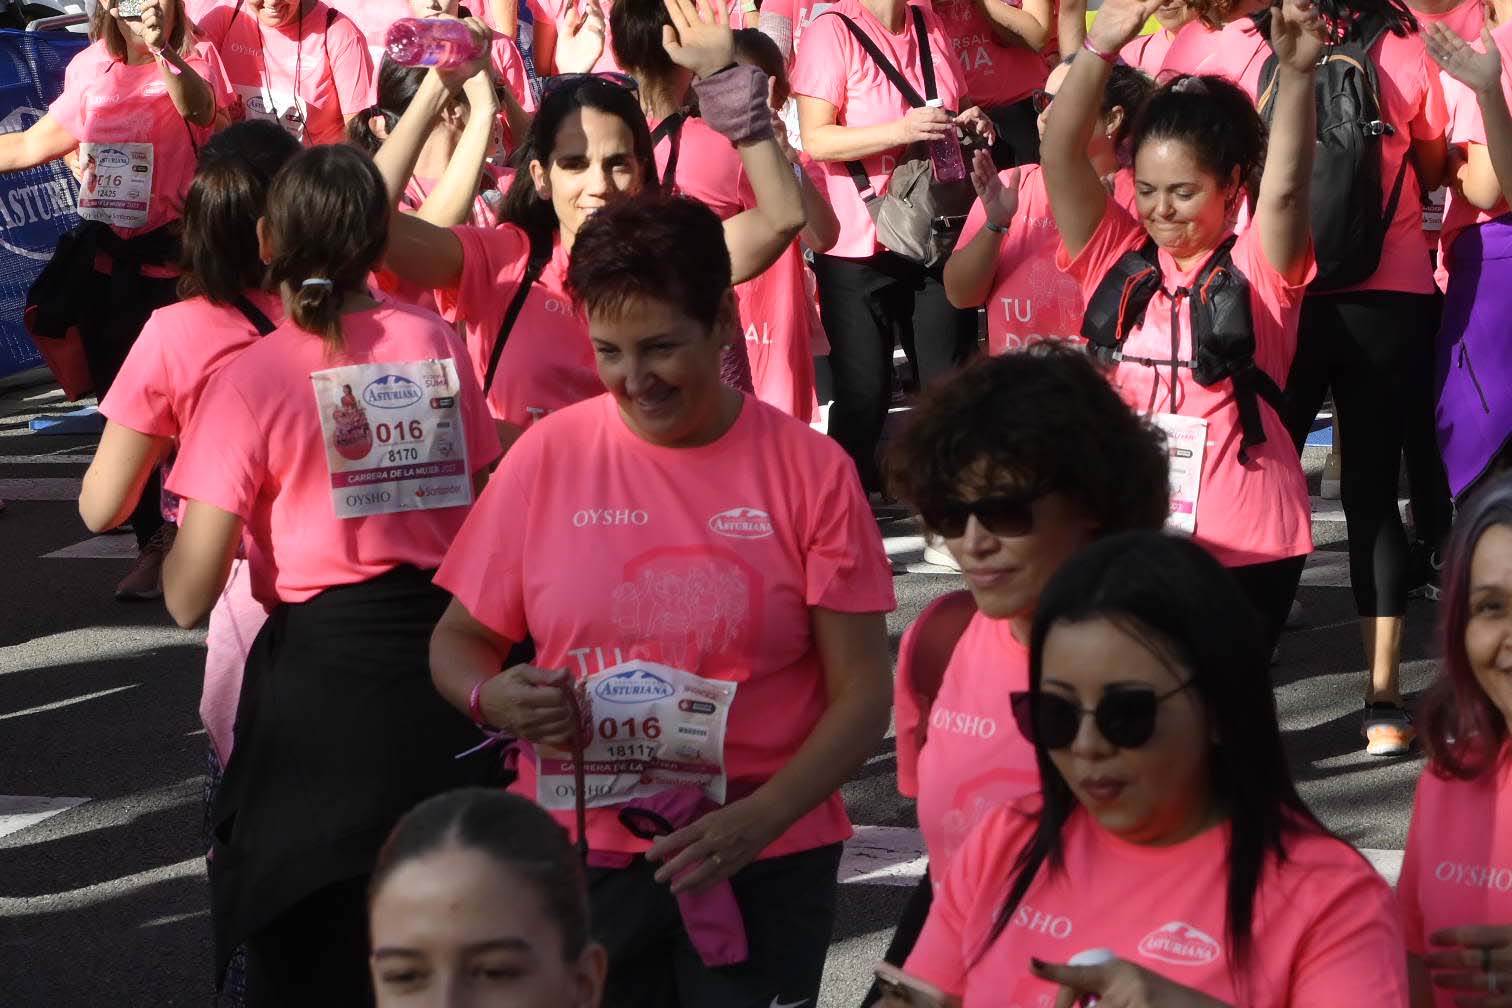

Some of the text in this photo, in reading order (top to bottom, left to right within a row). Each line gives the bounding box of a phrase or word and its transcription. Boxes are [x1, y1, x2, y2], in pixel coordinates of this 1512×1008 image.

[953, 33, 989, 48] RSAL
[1000, 298, 1031, 322] TU
[368, 389, 418, 402] ASTURIANA
[376, 420, 423, 443] 016
[388, 448, 418, 462] 8170
[348, 471, 388, 484] CARRERA
[390, 470, 401, 478] DE
[403, 469, 414, 477] LA
[346, 492, 391, 507] OYSHO
[572, 508, 649, 527] OYSHO
[715, 519, 775, 532] ASTURIANA
[602, 683, 667, 695] ASTURIANA
[599, 717, 662, 739] 016
[932, 708, 996, 739] OYSHO
[556, 784, 612, 798] OYHO
